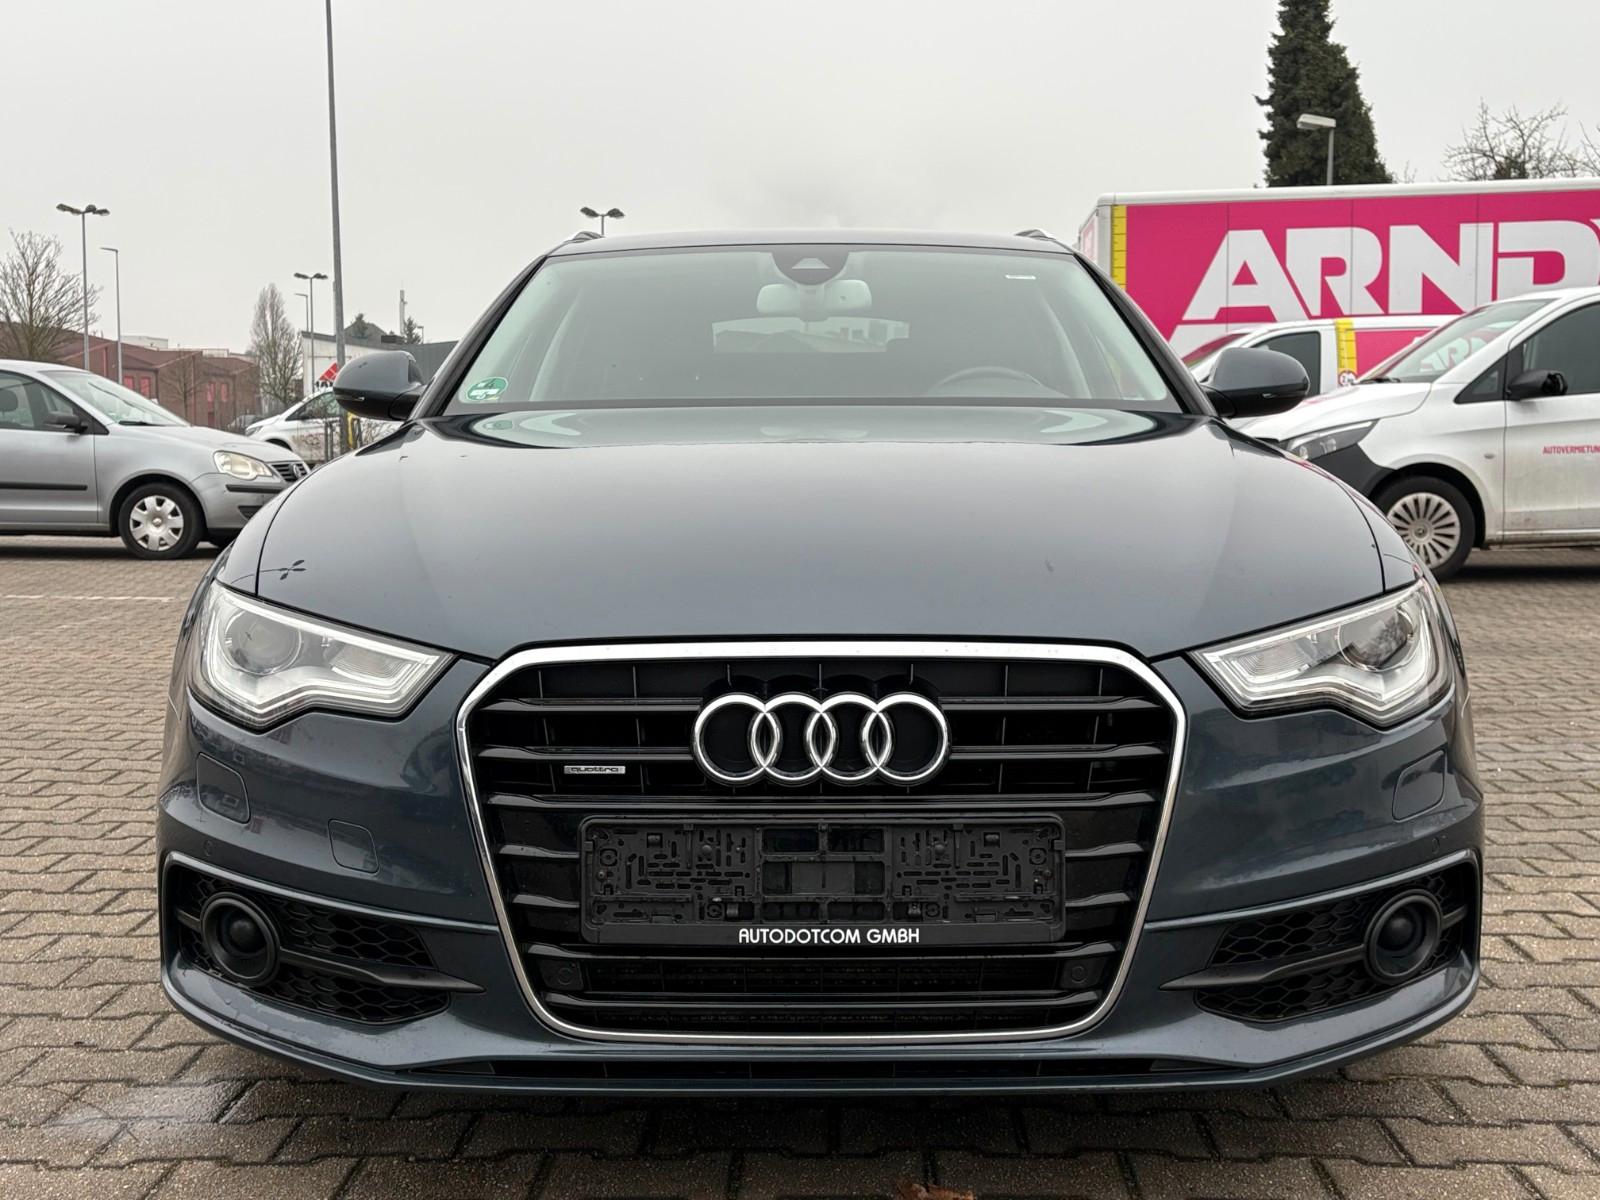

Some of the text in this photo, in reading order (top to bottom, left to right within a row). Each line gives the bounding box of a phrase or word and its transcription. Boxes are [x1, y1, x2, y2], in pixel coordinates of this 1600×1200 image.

[1182, 218, 1600, 321] ARND
[570, 766, 619, 775] quattro
[738, 927, 919, 943] AUTODOTCOM GMBH
